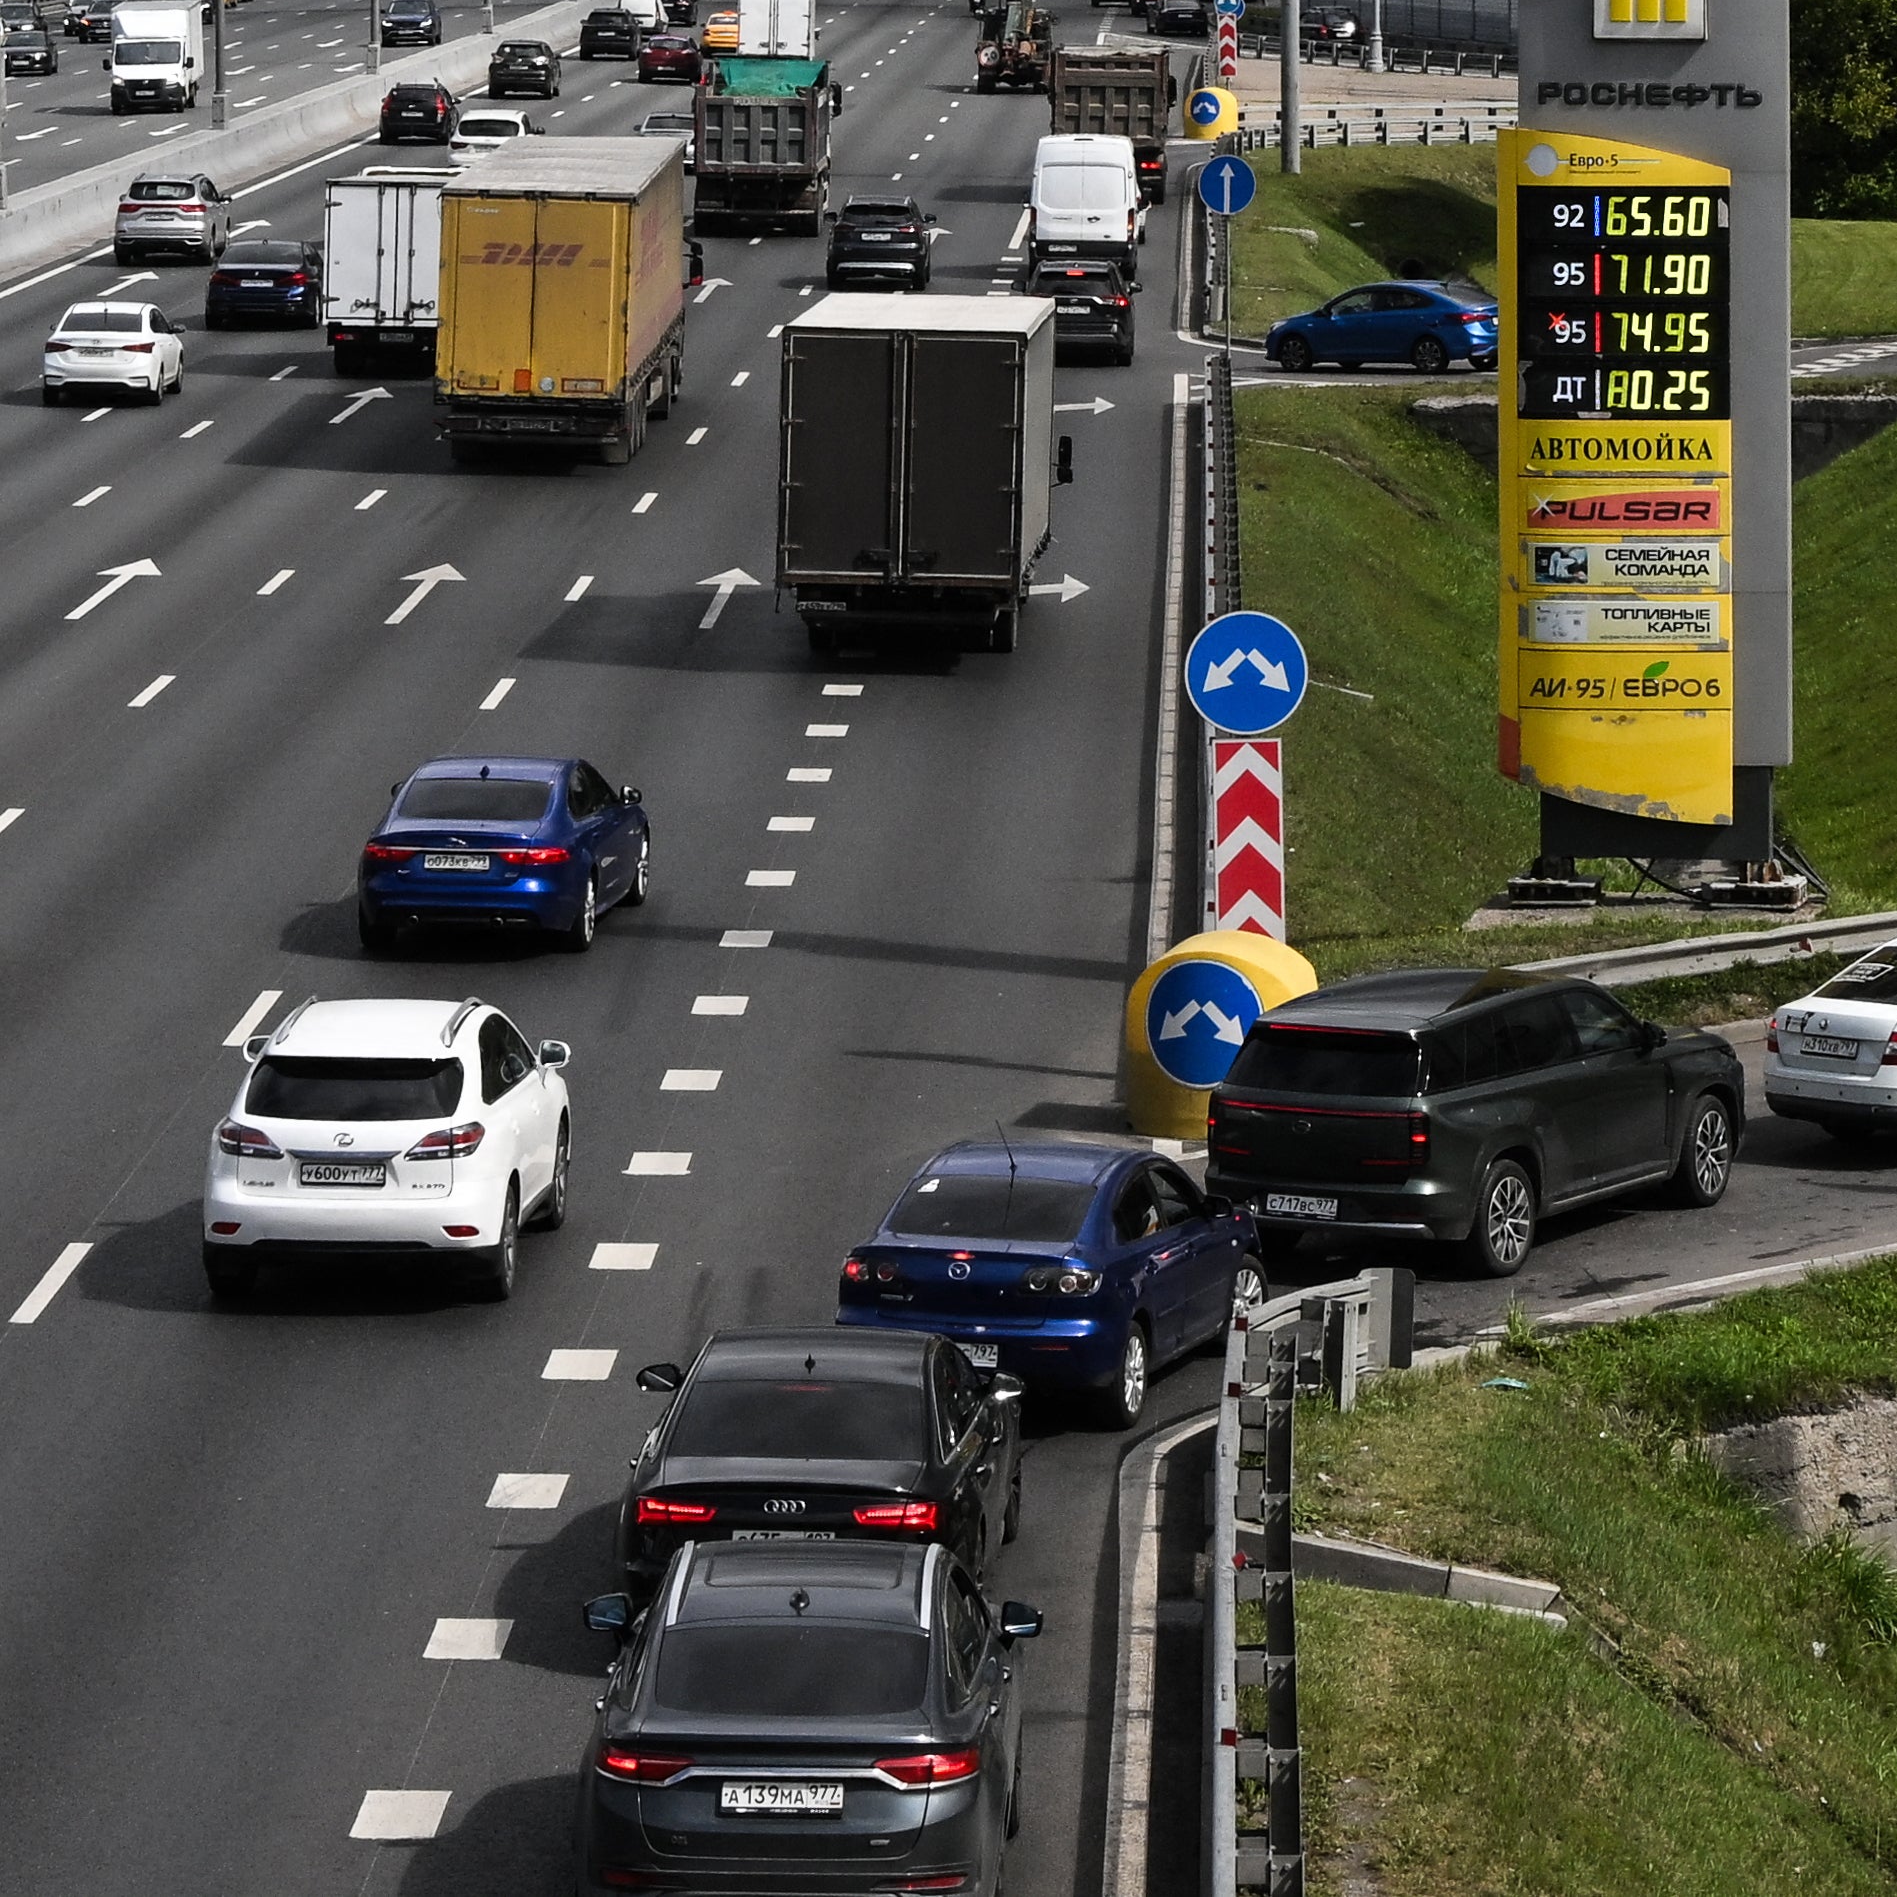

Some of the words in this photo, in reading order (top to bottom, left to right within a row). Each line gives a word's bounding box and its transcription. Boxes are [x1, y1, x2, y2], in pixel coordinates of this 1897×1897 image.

[1537, 81, 1762, 108] РОСНЕФТЬ
[1553, 204, 1585, 228] 92
[1606, 196, 1710, 236] 65.60
[482, 242, 583, 267] DHL
[1553, 262, 1585, 286] 95
[1610, 255, 1710, 295] 71.90
[1554, 319, 1586, 344] 95
[1610, 312, 1710, 353] 74.95
[1552, 376, 1586, 403] ДТ
[1530, 433, 1713, 461] АВТОМОЙКА
[1605, 546, 1710, 562] СЕМЕЙНАЯ
[1614, 564, 1710, 578] КОМАНДА
[1601, 608, 1711, 620] ТОПЛИВНЫЕ
[1647, 621, 1710, 633] КАРТЫ
